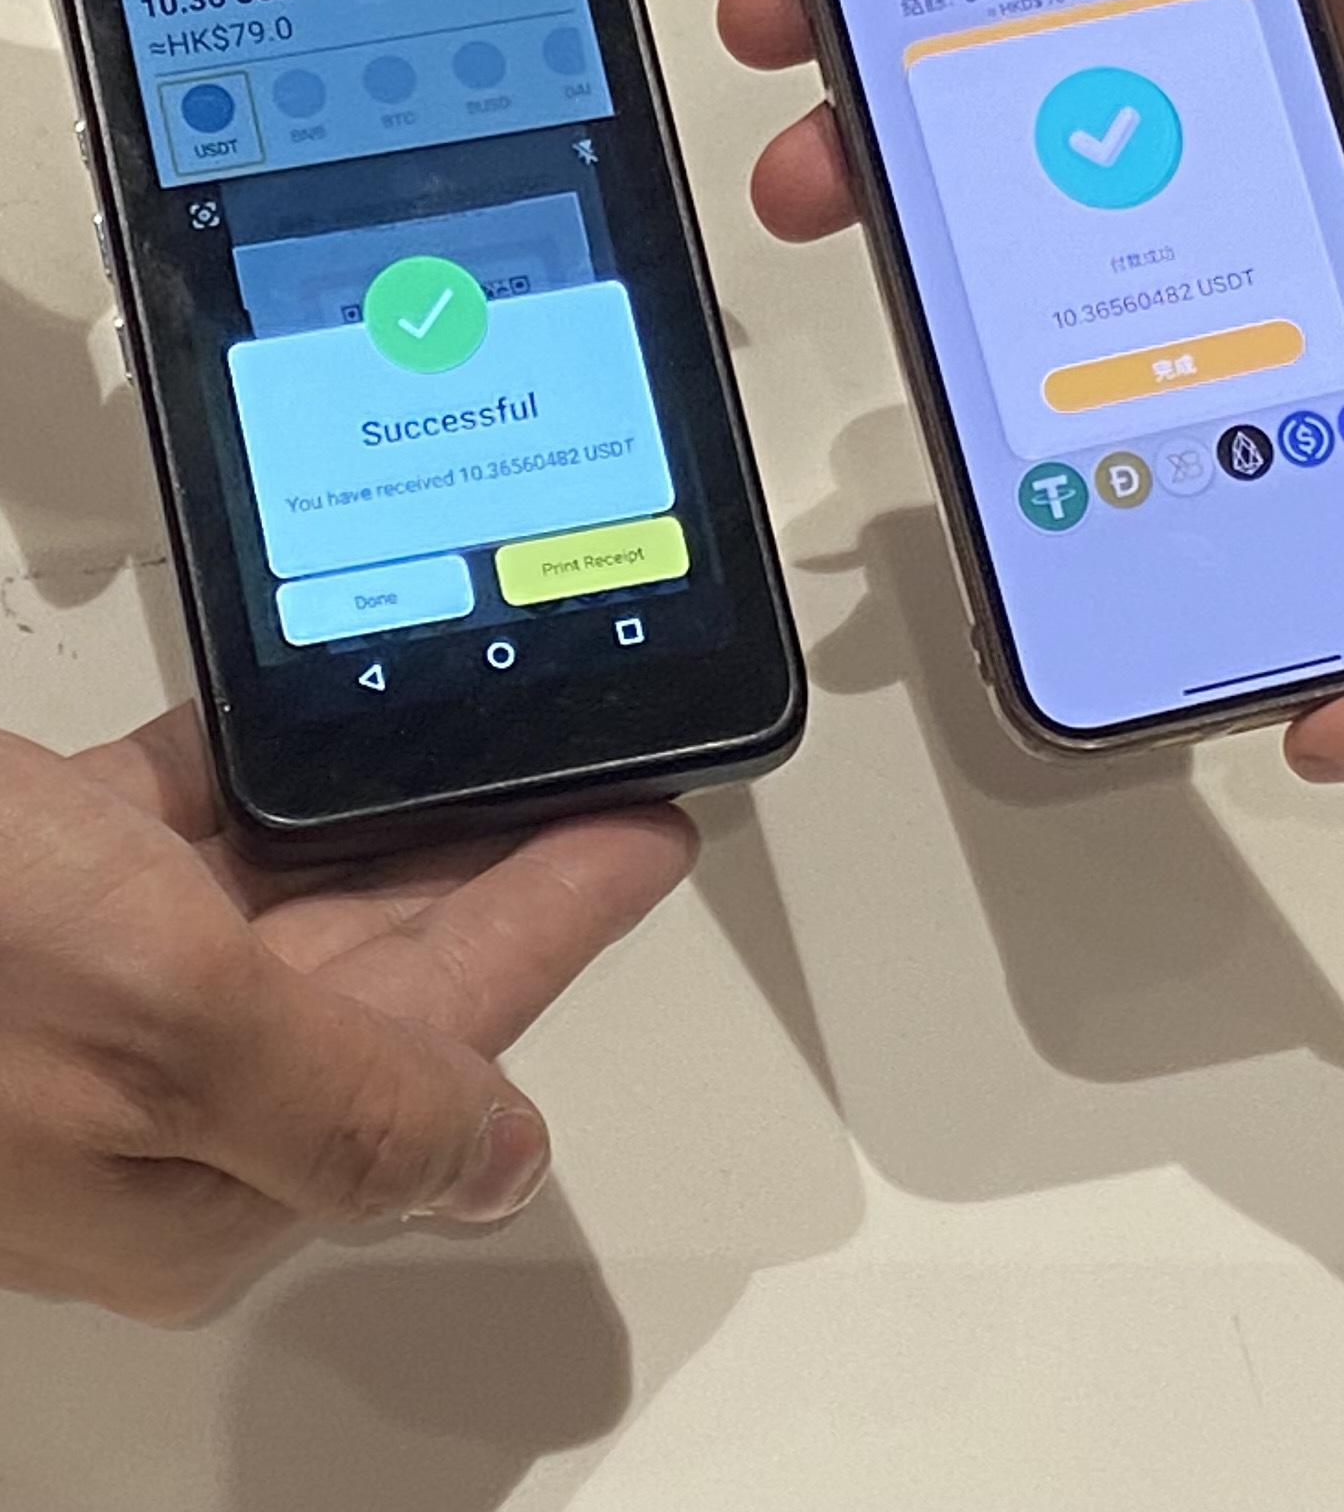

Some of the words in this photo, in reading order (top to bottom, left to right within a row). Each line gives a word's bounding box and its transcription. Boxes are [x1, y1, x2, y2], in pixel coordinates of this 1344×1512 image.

[381, 109, 417, 129] BTC
[193, 138, 239, 160] USDT
[1053, 283, 1193, 329] 10.36560482
[1199, 269, 1256, 297] USDT
[1152, 354, 1198, 383] 完成
[361, 392, 539, 448] Successful
[285, 494, 323, 514] You
[326, 482, 373, 507] have
[376, 468, 455, 497] received
[460, 448, 581, 483] 10.36560482
[583, 438, 635, 462] USDT
[541, 557, 580, 577] Print
[584, 546, 645, 572] Receipt
[354, 590, 398, 611] Done
